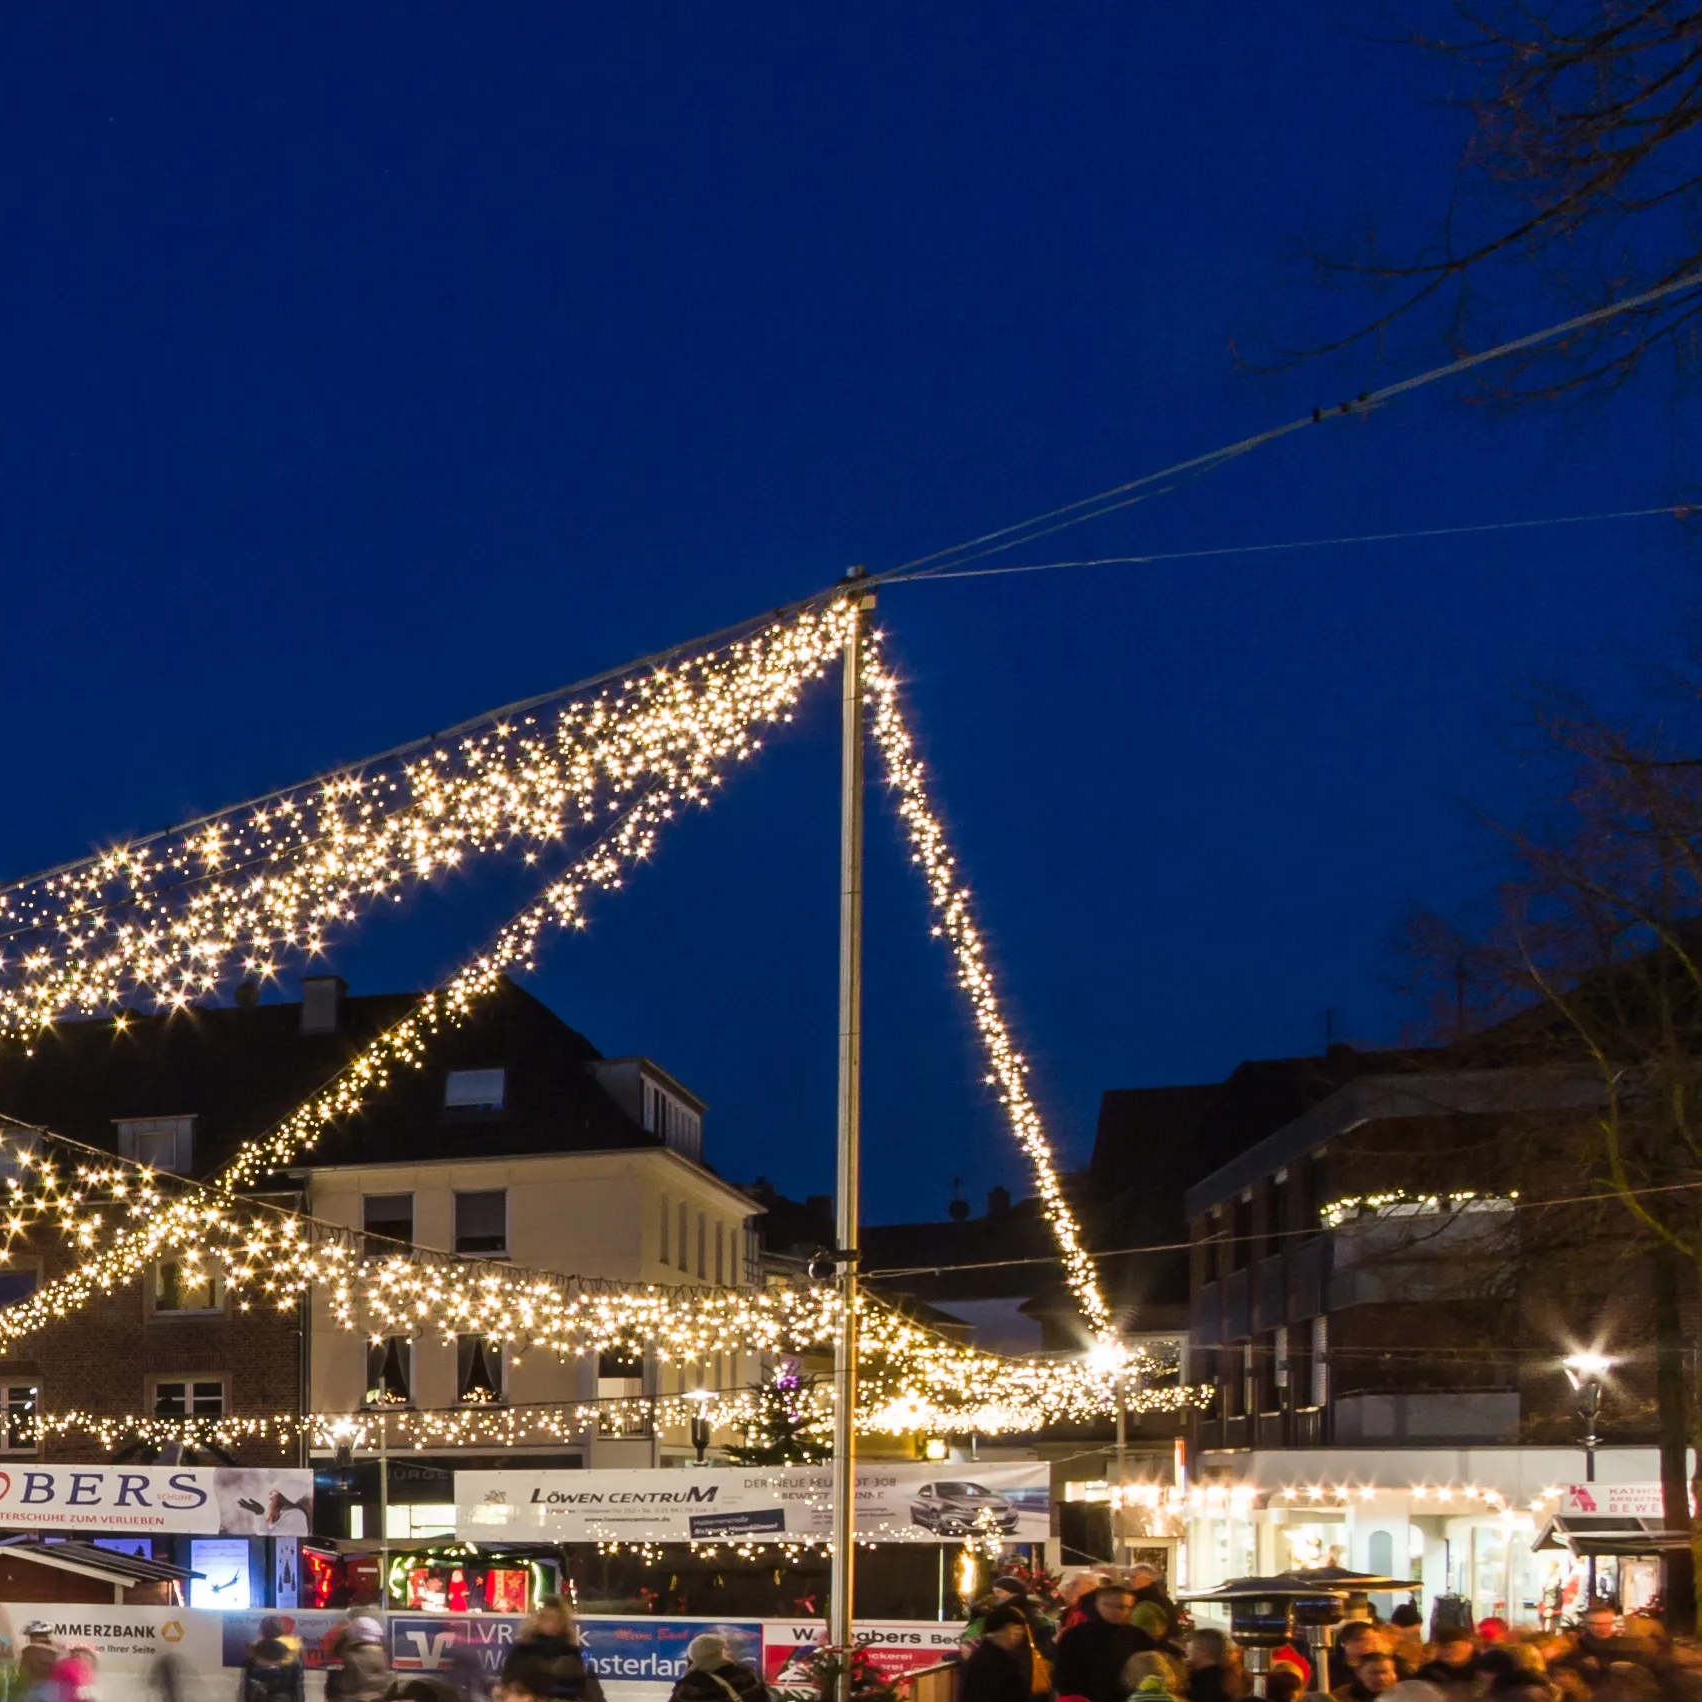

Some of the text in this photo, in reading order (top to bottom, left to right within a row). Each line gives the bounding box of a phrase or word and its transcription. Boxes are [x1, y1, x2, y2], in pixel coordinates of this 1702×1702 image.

[873, 1477, 897, 1488] 308
[529, 1487, 604, 1504] LÖWEN
[69, 1513, 98, 1524] ZUM
[101, 1515, 166, 1526] VERLIEBEN
[53, 1623, 156, 1639] MMERZBANK
[107, 1644, 130, 1654] Ihrer
[132, 1645, 156, 1655] Seite
